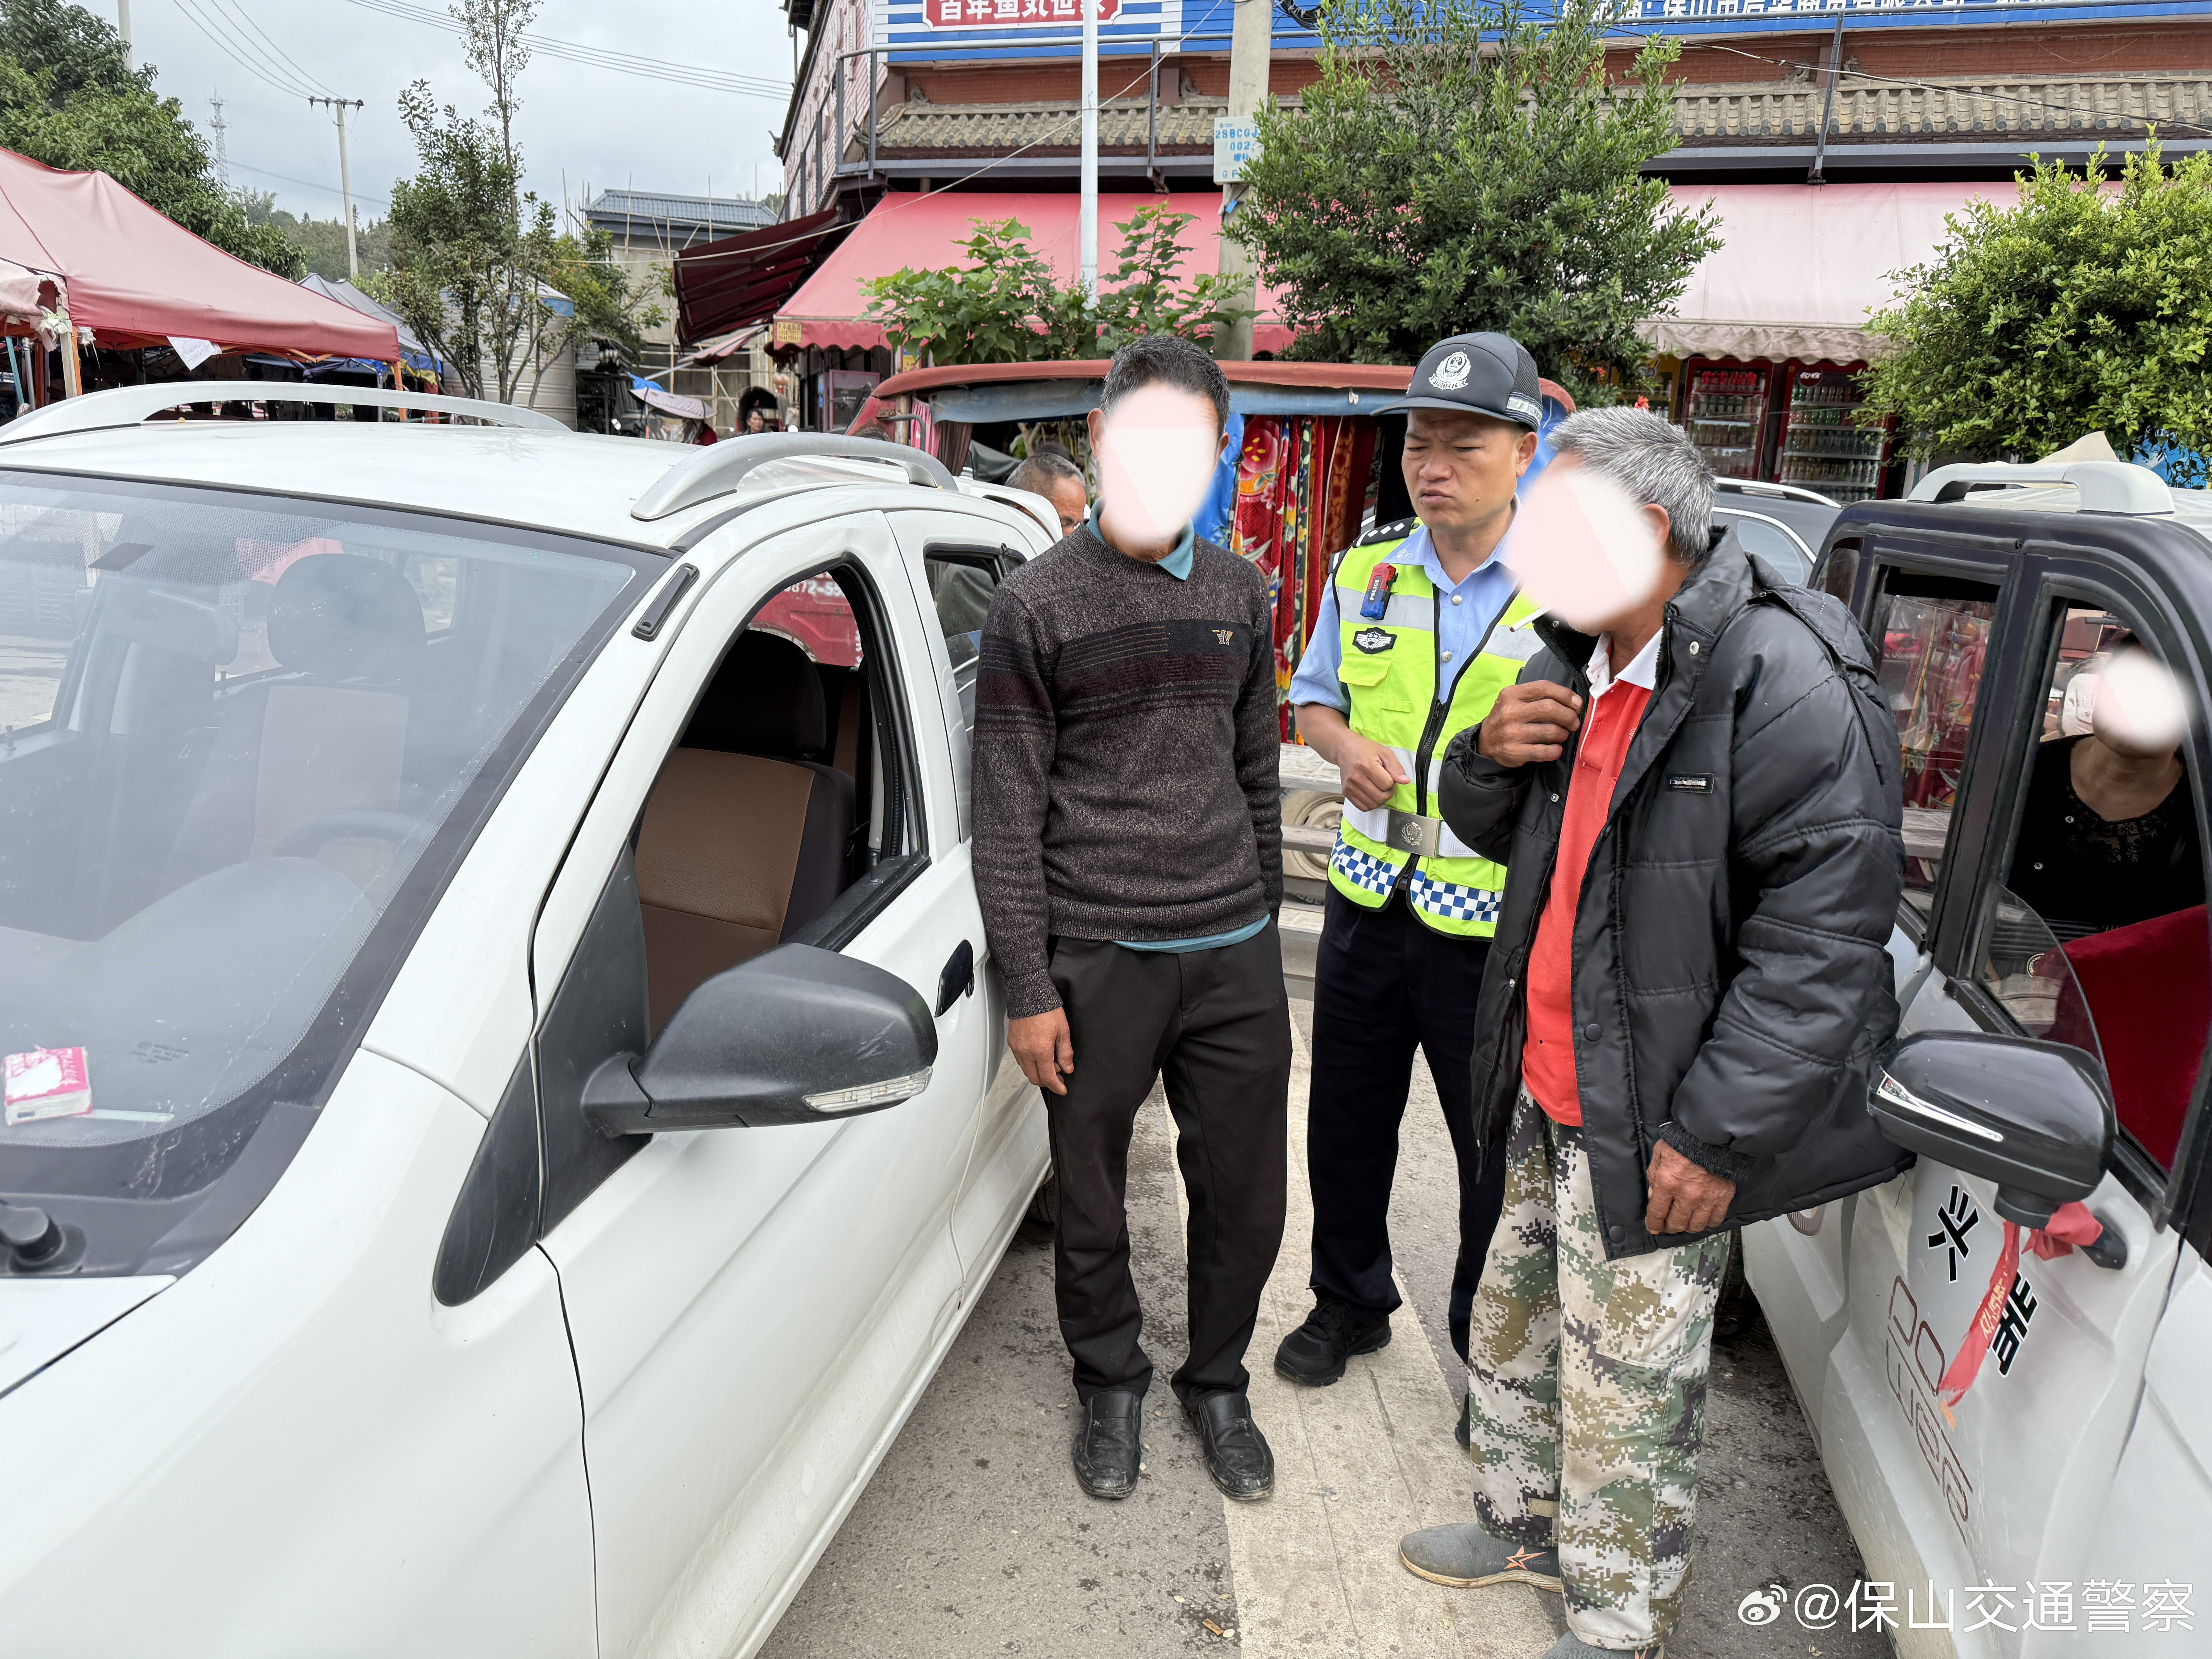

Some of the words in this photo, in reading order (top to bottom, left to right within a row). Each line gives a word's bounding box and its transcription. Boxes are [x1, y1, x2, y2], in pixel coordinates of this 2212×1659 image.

[941, 0, 1106, 20] 百年鱼丸世
[1369, 579, 1380, 601] POLICE
